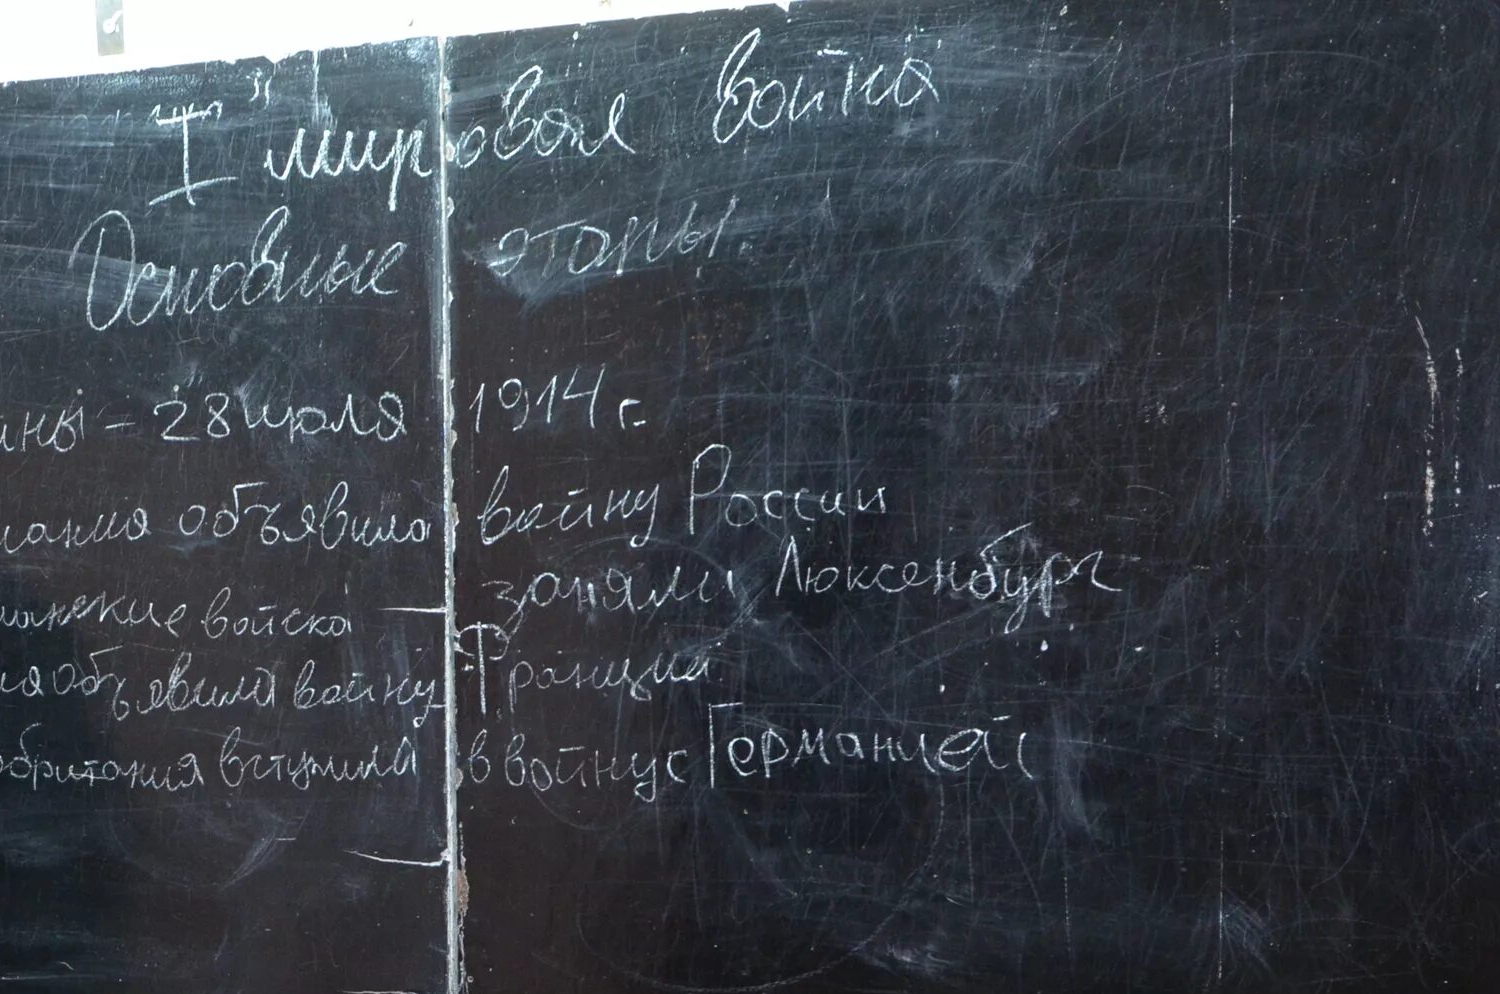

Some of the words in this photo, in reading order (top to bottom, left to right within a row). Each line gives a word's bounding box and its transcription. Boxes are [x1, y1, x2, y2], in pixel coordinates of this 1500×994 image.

[713, 28, 940, 144] война
[69, 205, 407, 331] Основные
[469, 363, 605, 433] 1914
[178, 481, 432, 550] объявила
[479, 465, 660, 548] войну
[688, 444, 887, 534] России
[201, 587, 353, 640] войска
